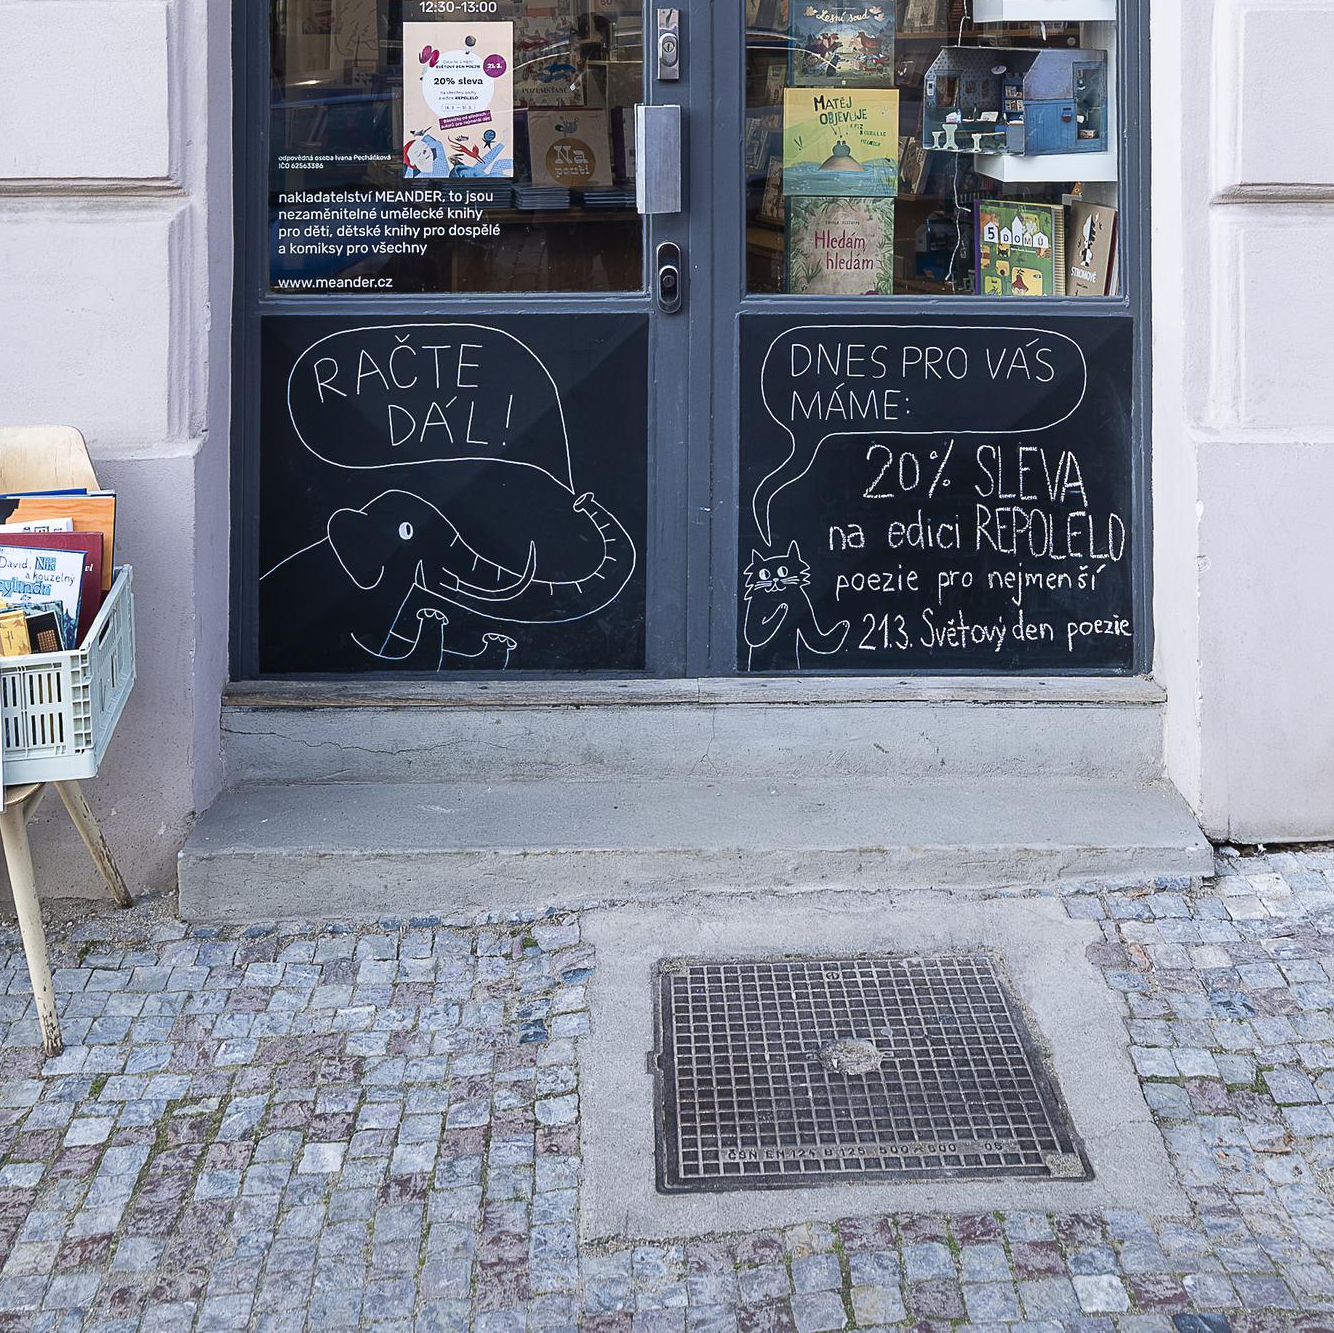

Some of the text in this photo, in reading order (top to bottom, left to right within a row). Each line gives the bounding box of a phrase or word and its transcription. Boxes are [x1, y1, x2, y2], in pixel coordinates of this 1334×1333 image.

[816, 8, 870, 24] Lesní soud
[434, 77, 484, 85] 20% sleva
[813, 95, 852, 112] MATĚJ
[819, 108, 868, 126] OBJEVUJE
[278, 154, 314, 162] odpovědná
[278, 161, 290, 169] IČO
[278, 190, 494, 204] nakladatelství MEANDER, to jsou
[278, 206, 483, 222] nezaměnitelné umělecké knihy
[278, 224, 501, 240] pro děti, dětské knihy pro dospělé
[988, 226, 995, 240] 5
[814, 229, 866, 253] Hledám,
[278, 242, 428, 257] a komiksy pro všechny
[827, 251, 874, 270] hledám
[278, 275, 393, 289] www.meander.cz
[790, 337, 1055, 382] DNES PRO VÁS
[313, 333, 483, 404] RAČTE
[791, 381, 910, 421] MÁME:
[862, 438, 1088, 508] 20% SLEVA
[828, 523, 865, 551] na
[887, 508, 961, 551] edici
[33, 571, 76, 587] kouzelný
[835, 563, 1106, 607] poezie pro nejmenší
[920, 608, 1006, 652] Světový
[1013, 609, 1054, 641] den
[1066, 614, 1133, 652] poezie
[728, 1148, 758, 1160] ČSN
[765, 1150, 785, 1160] EN
